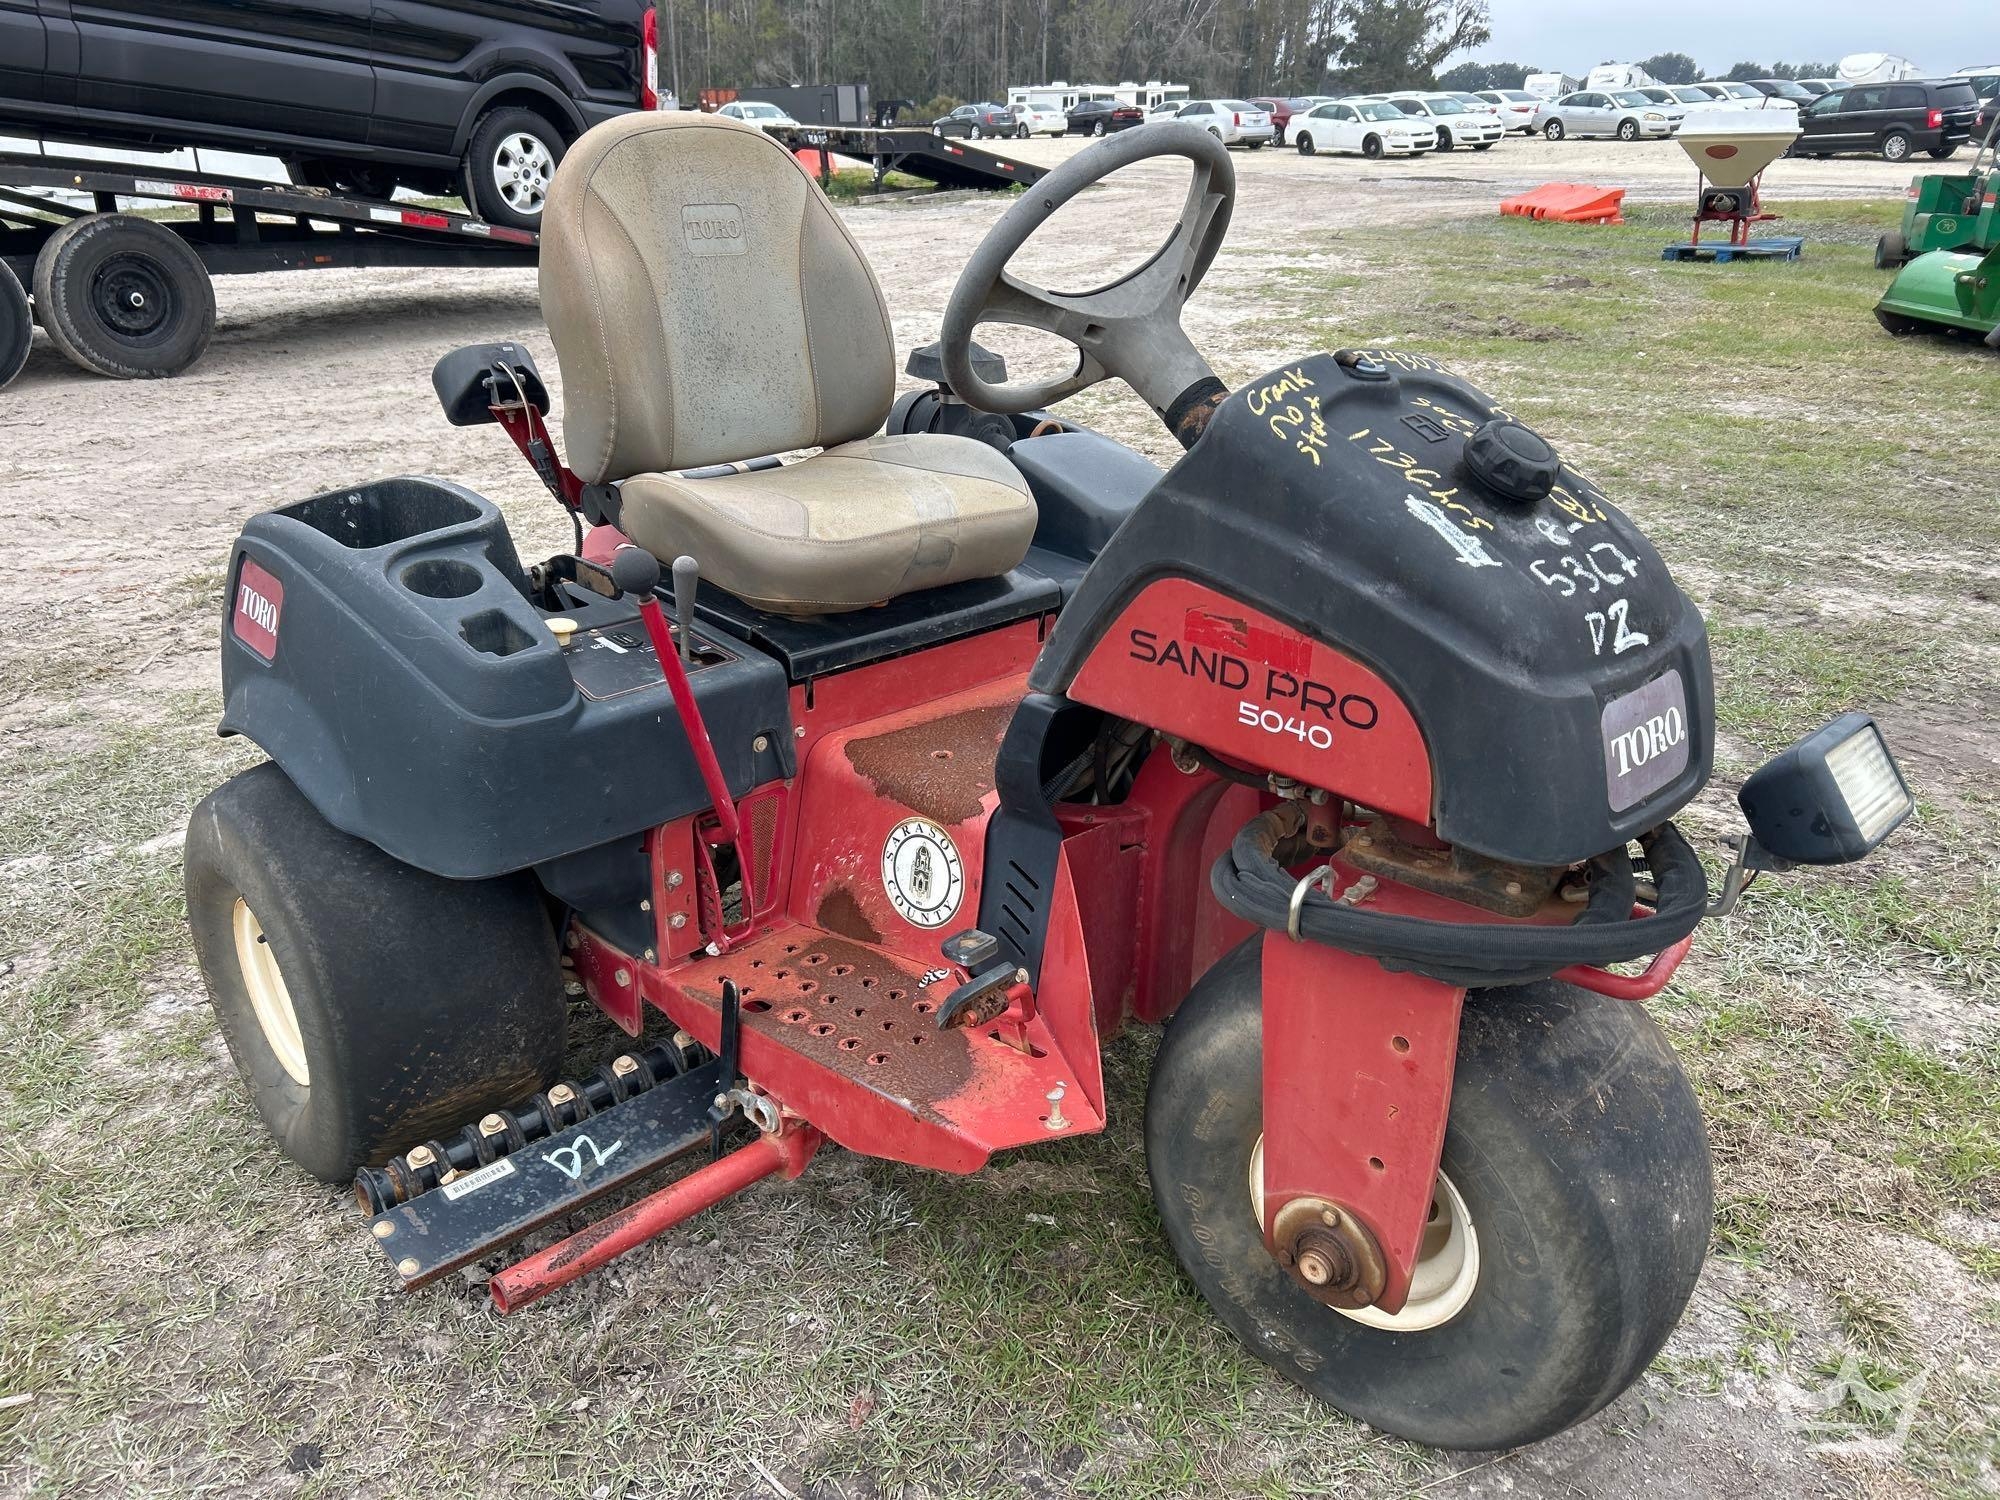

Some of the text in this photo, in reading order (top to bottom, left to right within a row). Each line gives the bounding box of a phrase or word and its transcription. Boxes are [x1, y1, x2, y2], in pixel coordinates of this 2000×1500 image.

[686, 218, 741, 240] TORO
[1129, 628, 1379, 731] SAND PRO
[1237, 700, 1333, 750] 5040
[886, 822, 961, 885] SARASOTA
[887, 879, 953, 924] COUNTY
